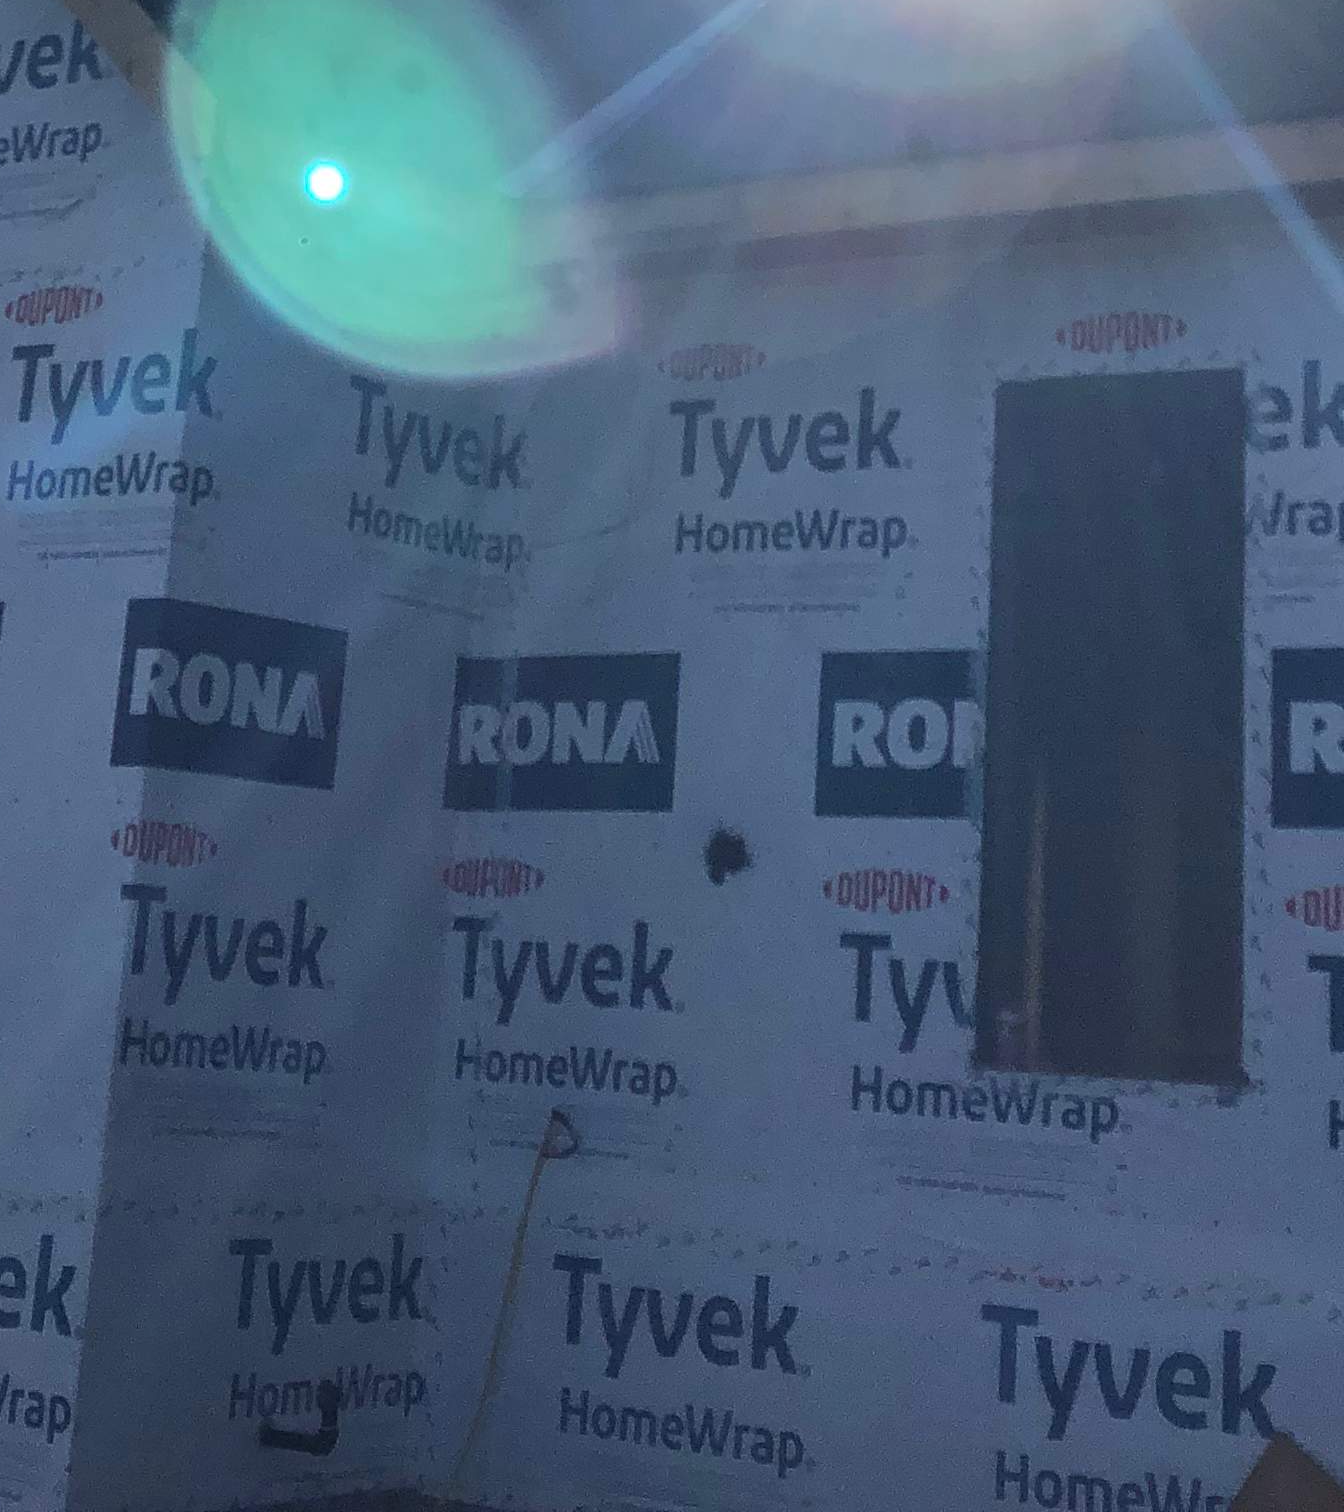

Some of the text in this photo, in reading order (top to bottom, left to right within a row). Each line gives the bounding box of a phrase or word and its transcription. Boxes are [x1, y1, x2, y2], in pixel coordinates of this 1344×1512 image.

[11, 328, 218, 444] Tyvek
[350, 374, 528, 489] Tyvek
[669, 388, 902, 500] Tyvek
[6, 452, 214, 506] HomeWrap
[348, 491, 524, 572] HomeWrap
[674, 508, 907, 559] HomeWrap
[127, 648, 324, 740] RONA
[458, 699, 659, 766] RONA
[834, 868, 936, 914] DUPONT
[119, 883, 327, 1005] Tyvek
[453, 916, 673, 1025] Tyvek
[120, 1017, 326, 1085] HomeWrap
[456, 1039, 677, 1104] HomeWrap
[851, 1065, 1118, 1142] HomeWrap
[229, 1233, 423, 1356] Tyvek
[554, 1253, 797, 1378] Tyvek
[228, 1363, 425, 1420] HomWrap
[982, 1304, 1276, 1441] Tyvek
[559, 1388, 804, 1477] HomeWrap
